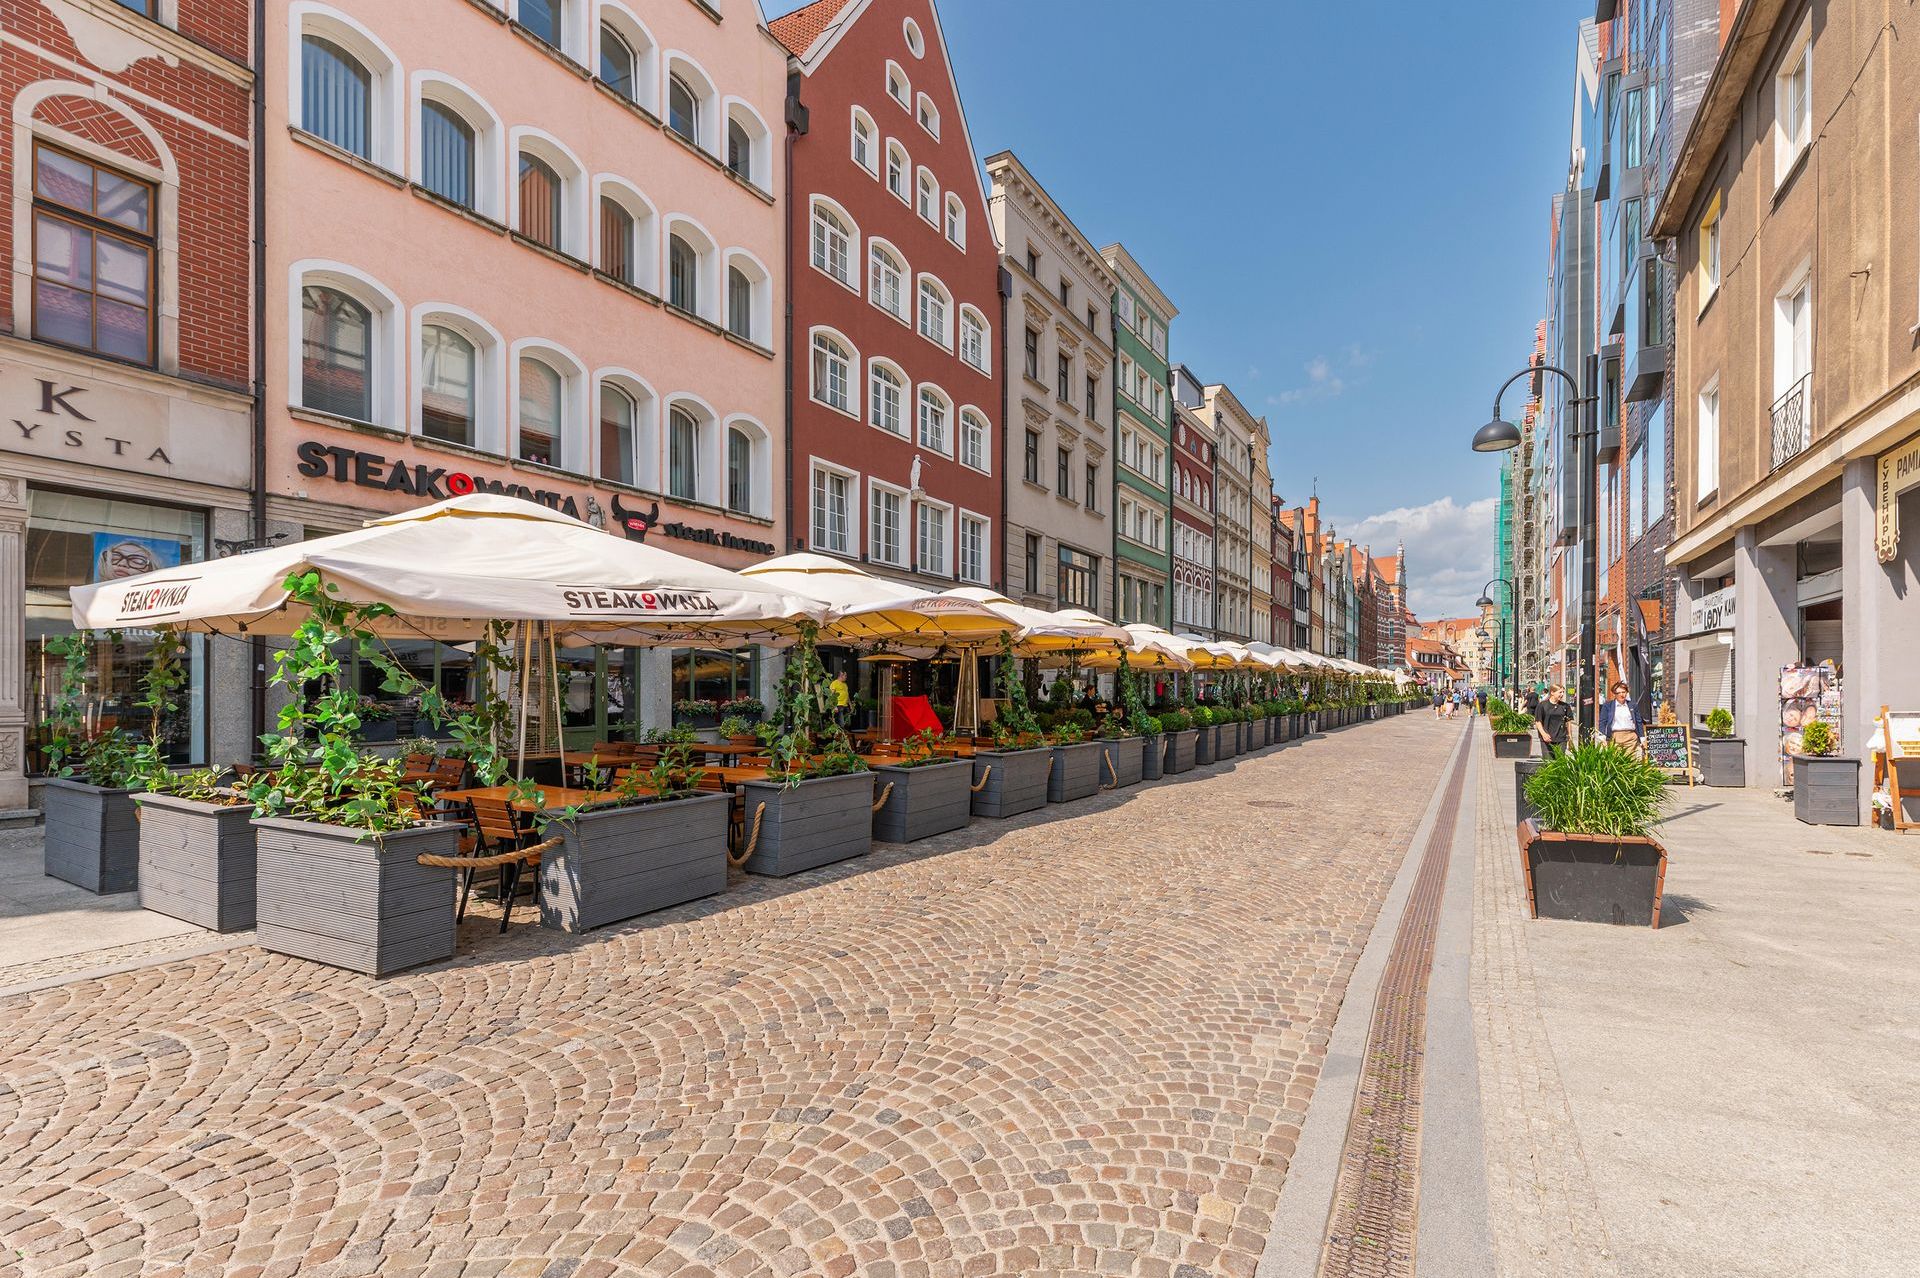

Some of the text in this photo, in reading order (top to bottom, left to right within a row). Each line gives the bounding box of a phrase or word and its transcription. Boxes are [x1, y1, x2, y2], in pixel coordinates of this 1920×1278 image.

[1882, 459, 1890, 547] СУВЕНИРЫ
[663, 523, 723, 546] steak
[121, 584, 191, 613] STEAKOWNIA
[563, 591, 719, 611] STEAKOWNIA
[1703, 605, 1723, 631] LODY
